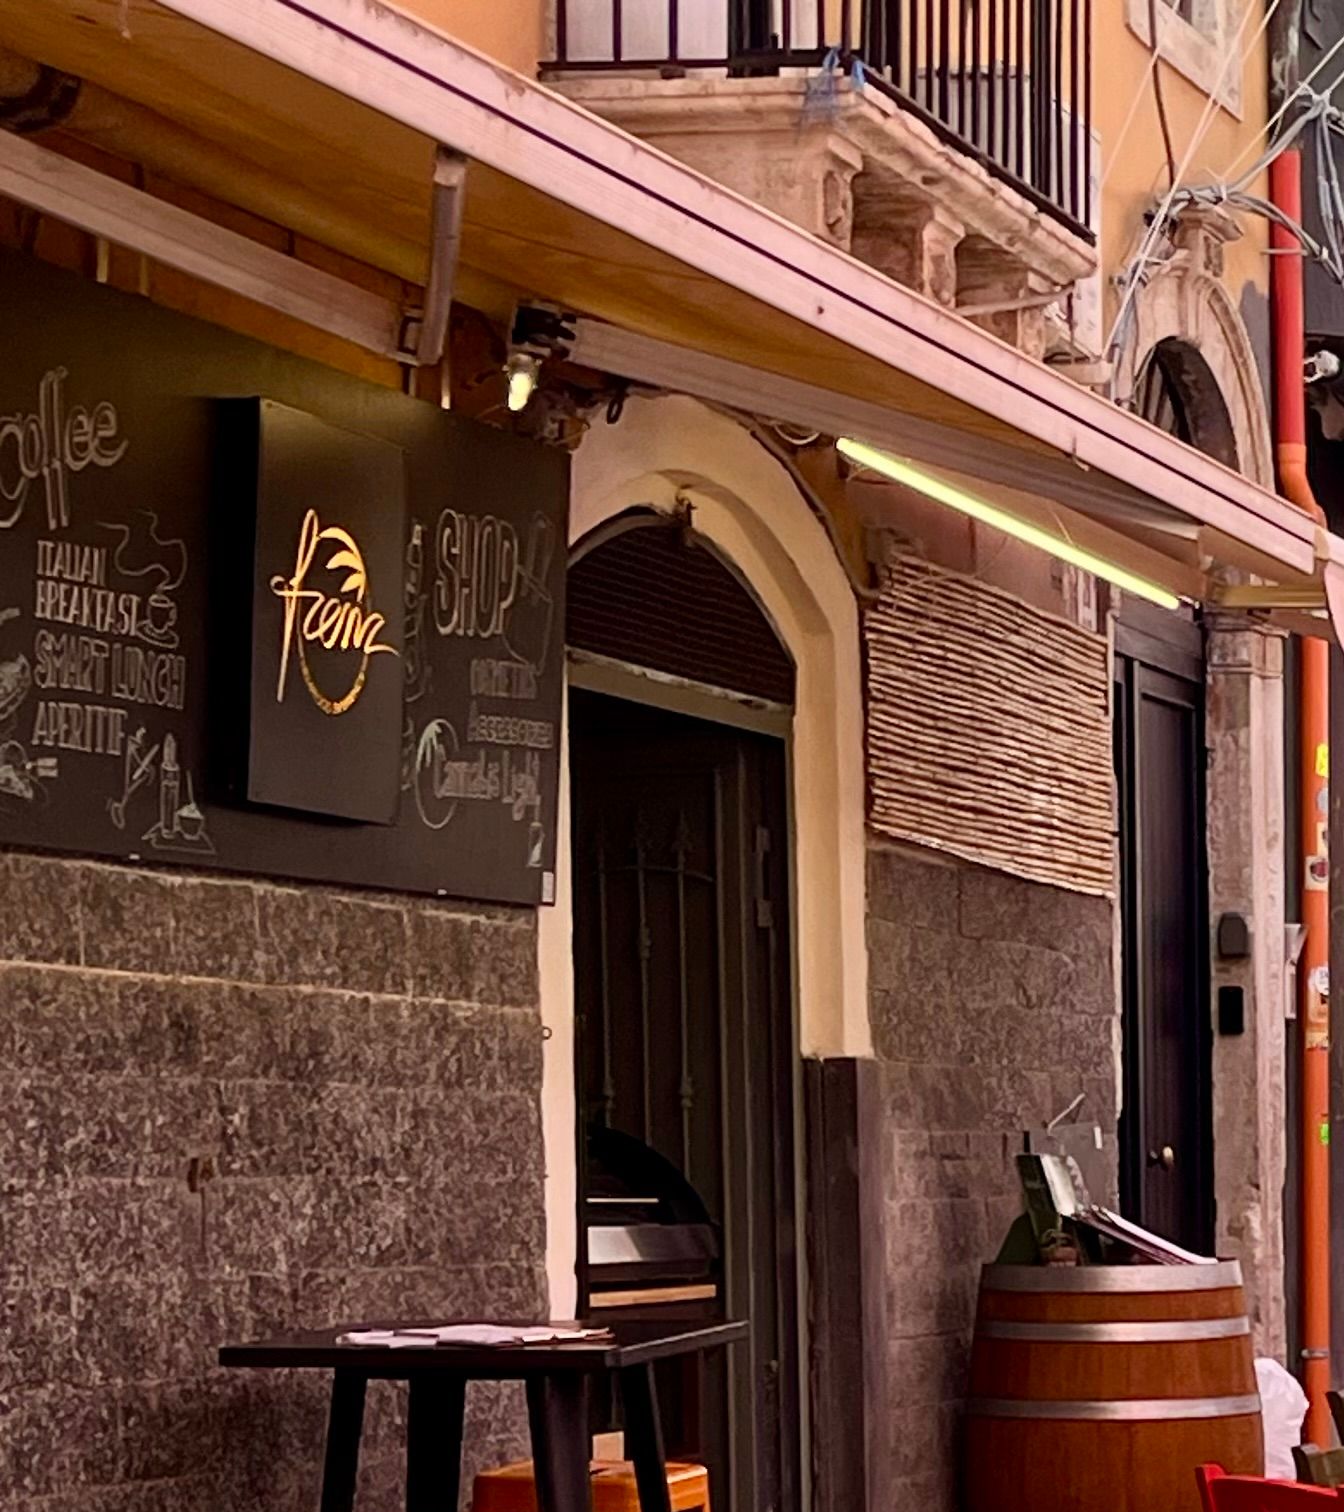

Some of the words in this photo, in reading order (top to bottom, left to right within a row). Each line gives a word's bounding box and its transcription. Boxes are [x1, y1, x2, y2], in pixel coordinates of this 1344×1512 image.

[36, 539, 107, 587] ITALIAN
[433, 508, 519, 638] SHOP
[34, 579, 141, 637] BREAKFAST
[33, 628, 110, 695] SMART
[31, 700, 129, 757] APERITIF
